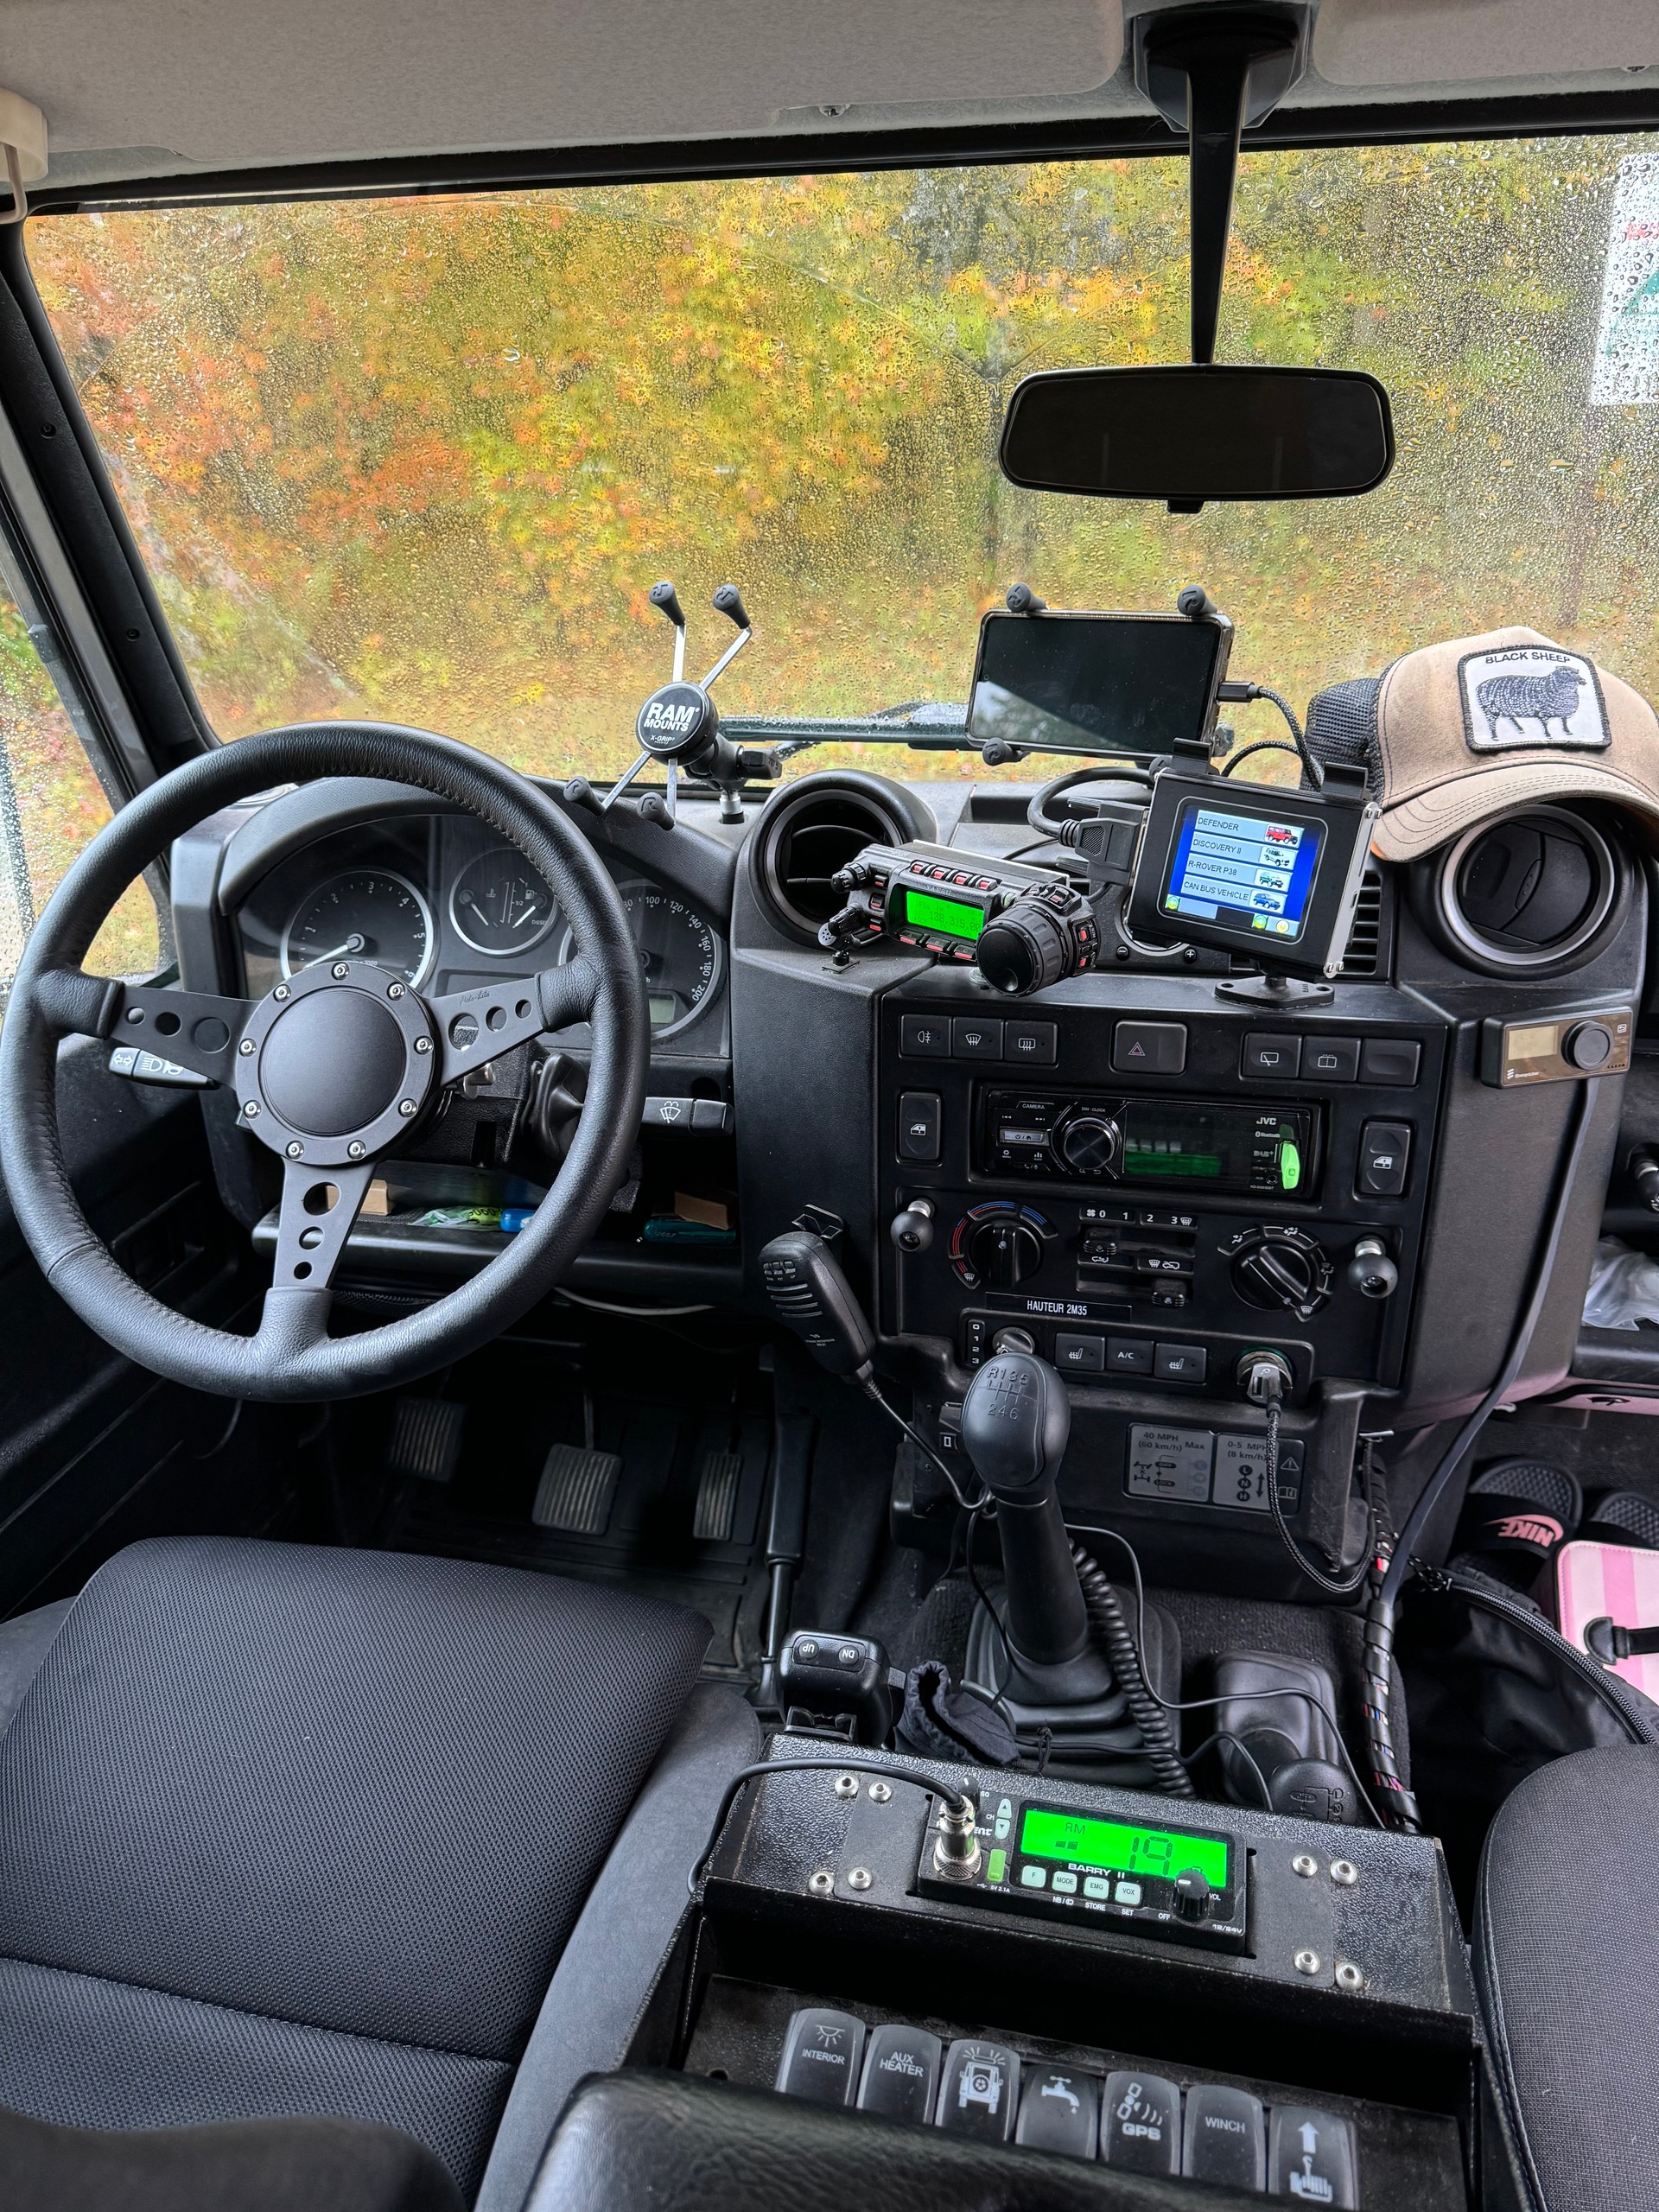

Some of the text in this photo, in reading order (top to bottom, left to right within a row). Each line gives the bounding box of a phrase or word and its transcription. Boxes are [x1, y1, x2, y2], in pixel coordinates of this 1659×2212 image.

[1485, 652, 1570, 664] BLACK SHEEP
[646, 702, 696, 723] RAM
[643, 718, 690, 732] MOUNTS
[1198, 817, 1239, 831] DEFENDER
[1192, 838, 1236, 853] DISCOVERY
[1188, 860, 1237, 876] R-ROVER P38
[368, 881, 375, 890] 3
[1184, 880, 1249, 900] CAN BUS VEHICLE
[330, 893, 337, 902] 2
[645, 896, 660, 905] 100
[670, 900, 683, 912] 120
[689, 914, 702, 929] 140
[701, 936, 711, 951] 160
[702, 961, 712, 976] 180
[691, 984, 705, 1001] 200
[1255, 1116, 1277, 1125] JVC
[1099, 1210, 1128, 1220] 0 1
[1147, 1214, 1178, 1224] 2 3
[1027, 1300, 1087, 1316] HAUTEUR 2M35
[1117, 1351, 1135, 1360] A/C
[987, 1366, 1029, 1386] R 1 3 5
[988, 1403, 1019, 1420] 2 4 6
[1143, 1431, 1179, 1442] 40 MPH
[1138, 1440, 1205, 1452] (60 km/h) Max
[1227, 1440, 1268, 1452] 0-5 MPH
[1227, 1450, 1237, 1459] (8
[1497, 1521, 1554, 1548] NIKE
[802, 1643, 815, 1654] UP
[842, 1649, 855, 1659] DN
[1128, 1835, 1173, 1877] 19
[1068, 1863, 1126, 1879] BARRY II
[1056, 1876, 1074, 1885] MODE
[1090, 1882, 1103, 1891] EMG
[1209, 1892, 1222, 1901] VOL
[1084, 1902, 1106, 1911] STORE
[1122, 1908, 1135, 1916] SET
[1211, 1923, 1243, 1934] 12/24V
[802, 2048, 845, 2065] INTERIOR
[890, 2051, 914, 2064] AUX
[880, 2058, 924, 2078] HEATER
[1205, 2116, 1245, 2133] WINCH
[1122, 2122, 1161, 2141] GPS
